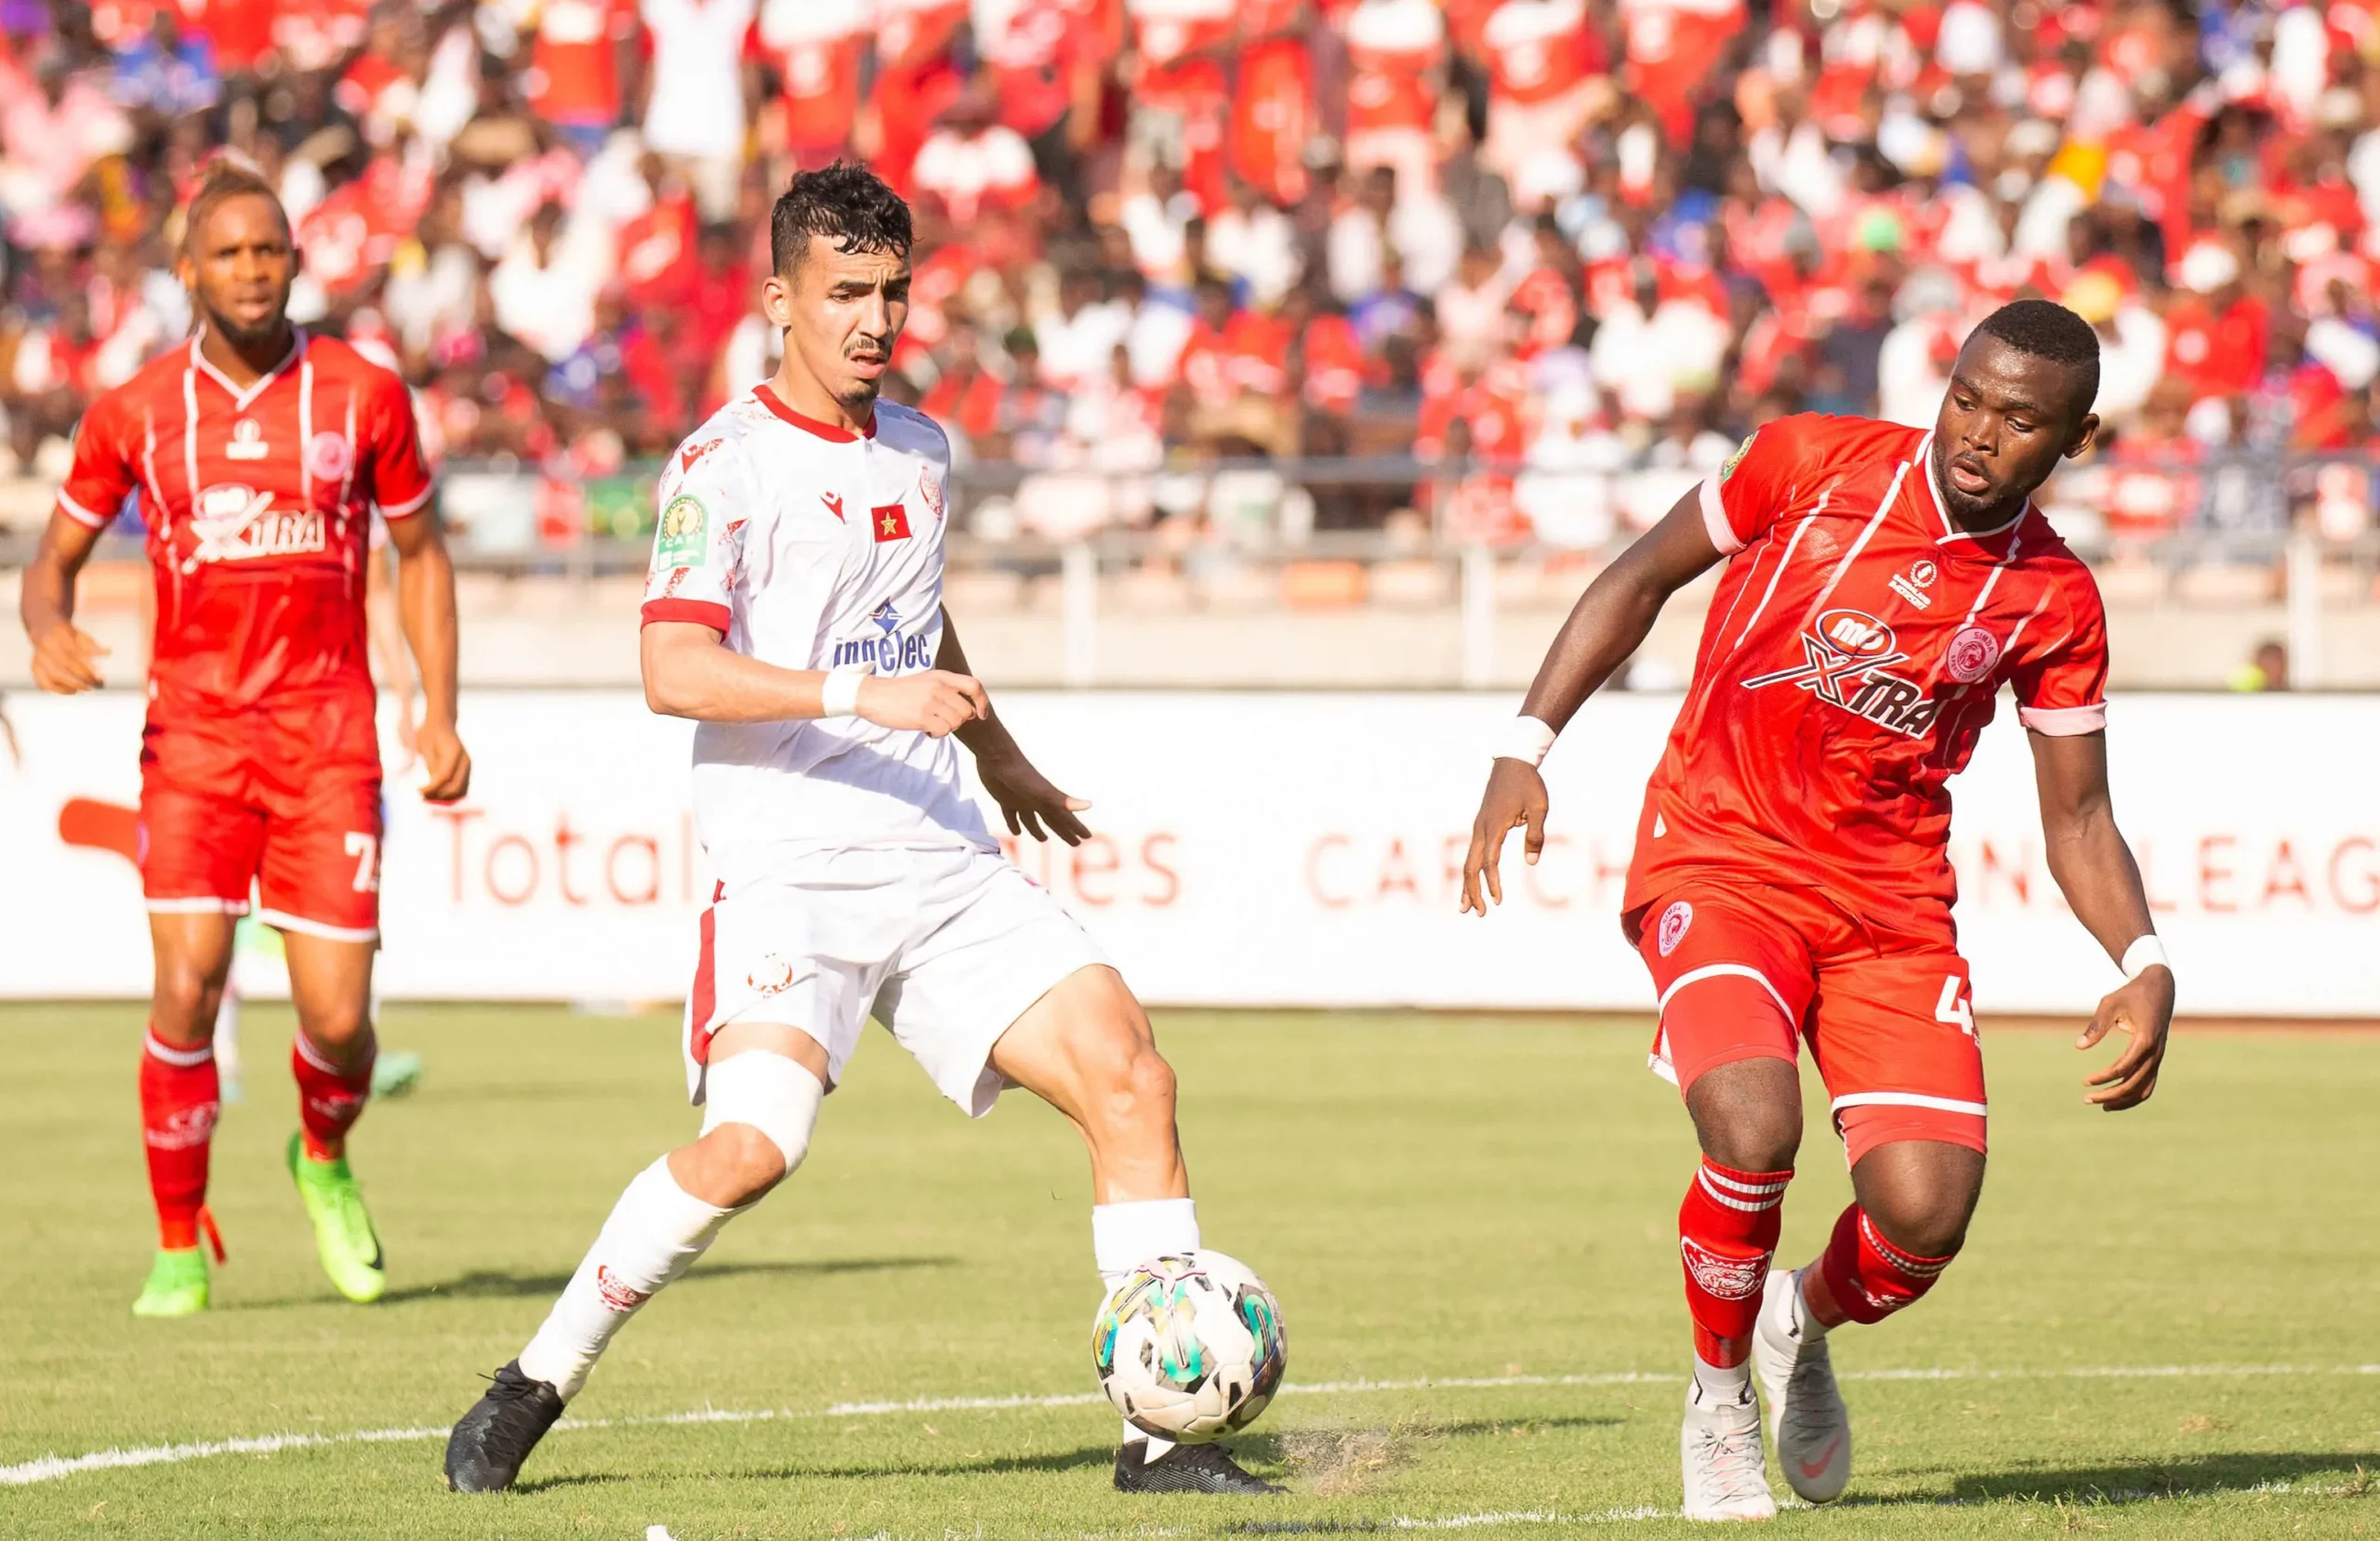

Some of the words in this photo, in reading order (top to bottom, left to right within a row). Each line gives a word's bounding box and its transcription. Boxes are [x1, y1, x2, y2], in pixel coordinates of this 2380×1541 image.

[181, 491, 325, 574] XTRA
[1974, 632, 1994, 652] SIMBA
[1739, 631, 1937, 741] XTRA
[1935, 974, 1974, 1036] 4
